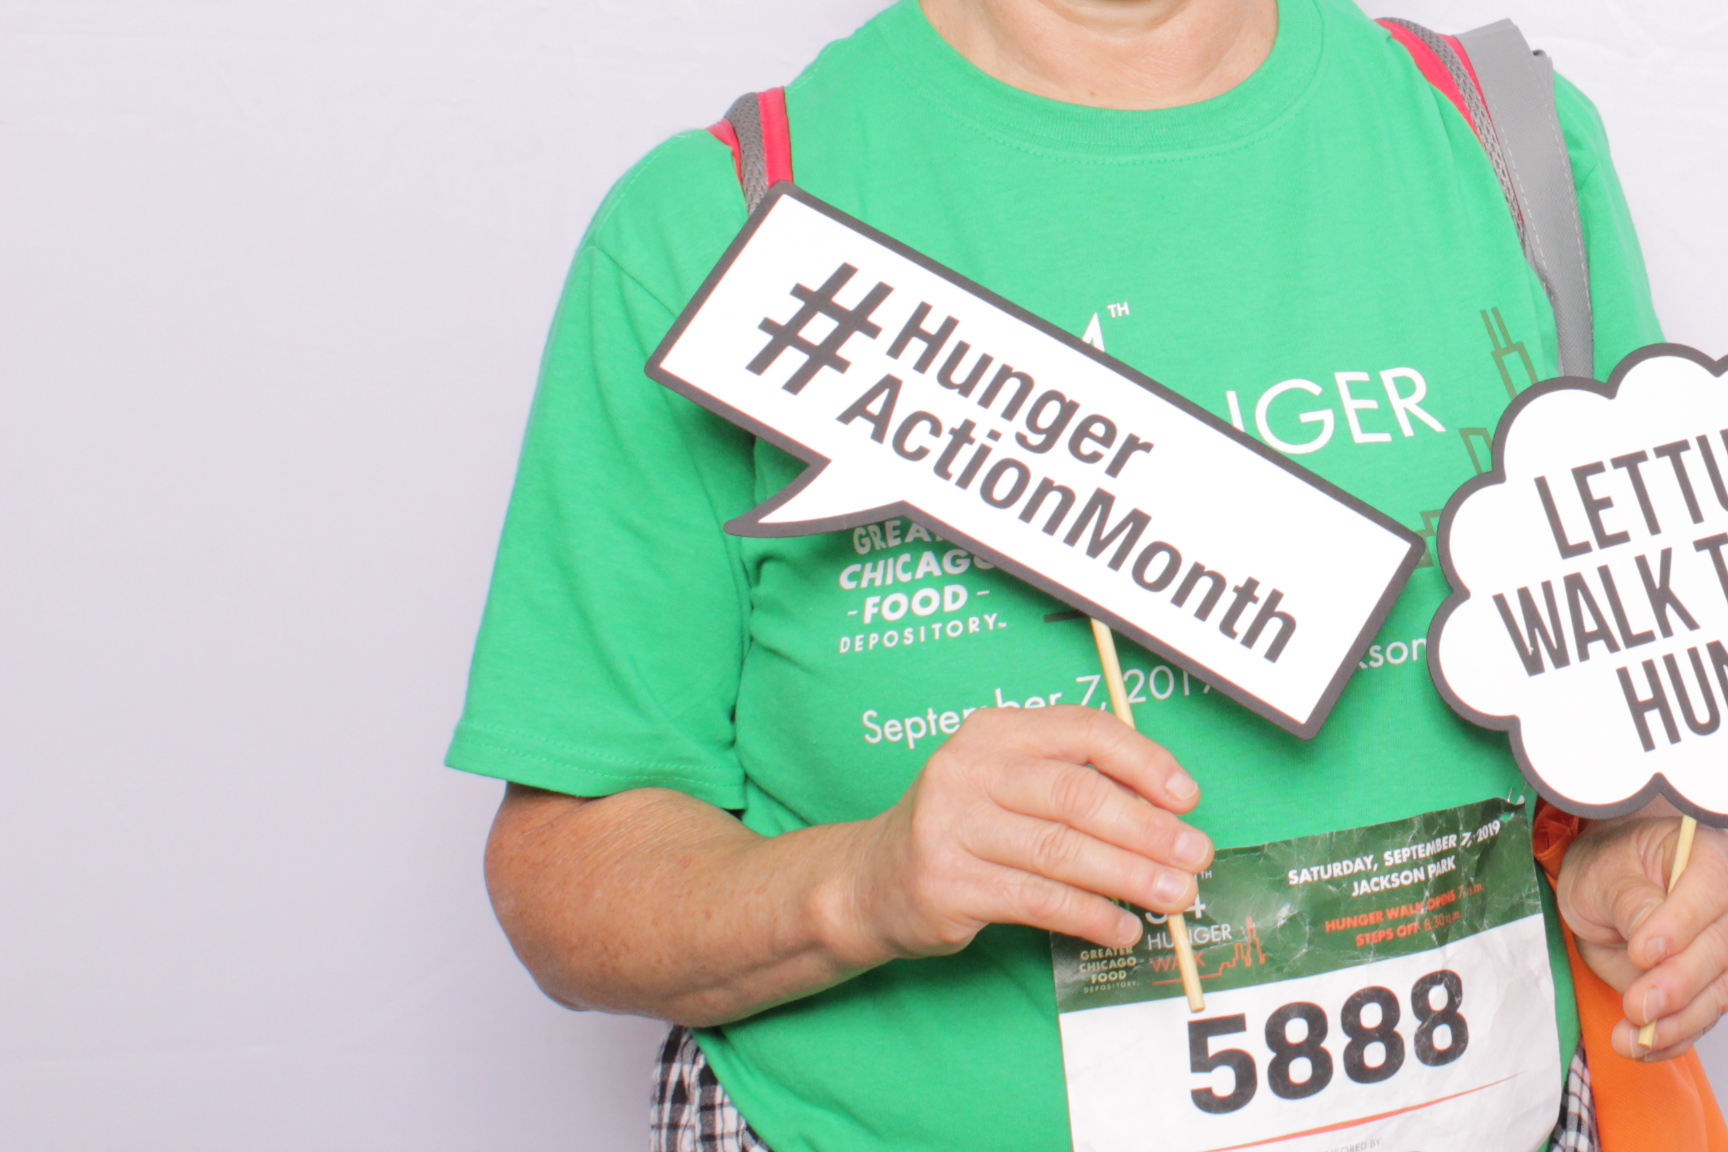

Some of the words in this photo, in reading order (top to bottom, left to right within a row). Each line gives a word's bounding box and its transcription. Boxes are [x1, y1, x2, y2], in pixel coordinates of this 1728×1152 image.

[745, 261, 1154, 479] #Hunger
[1226, 366, 1447, 455] GER
[836, 374, 1298, 664] ActionMonth
[853, 519, 945, 555] GREA
[1492, 546, 1701, 677] WALK
[1123, 664, 1211, 704] 201
[1288, 855, 1378, 886] SATURDAY,
[1383, 834, 1458, 866] SEPTEMBER
[1476, 819, 1501, 844] 2019
[1352, 866, 1425, 897] JACKSON
[1427, 855, 1457, 879] PARK
[1324, 910, 1384, 933] HUNGER
[1385, 902, 1424, 920] WALK
[1355, 928, 1394, 947] STEPS
[1396, 921, 1420, 938] OFF
[1079, 956, 1137, 973] CHICAGO
[1091, 969, 1127, 985] FOOD
[1187, 968, 1470, 1116] 5888
